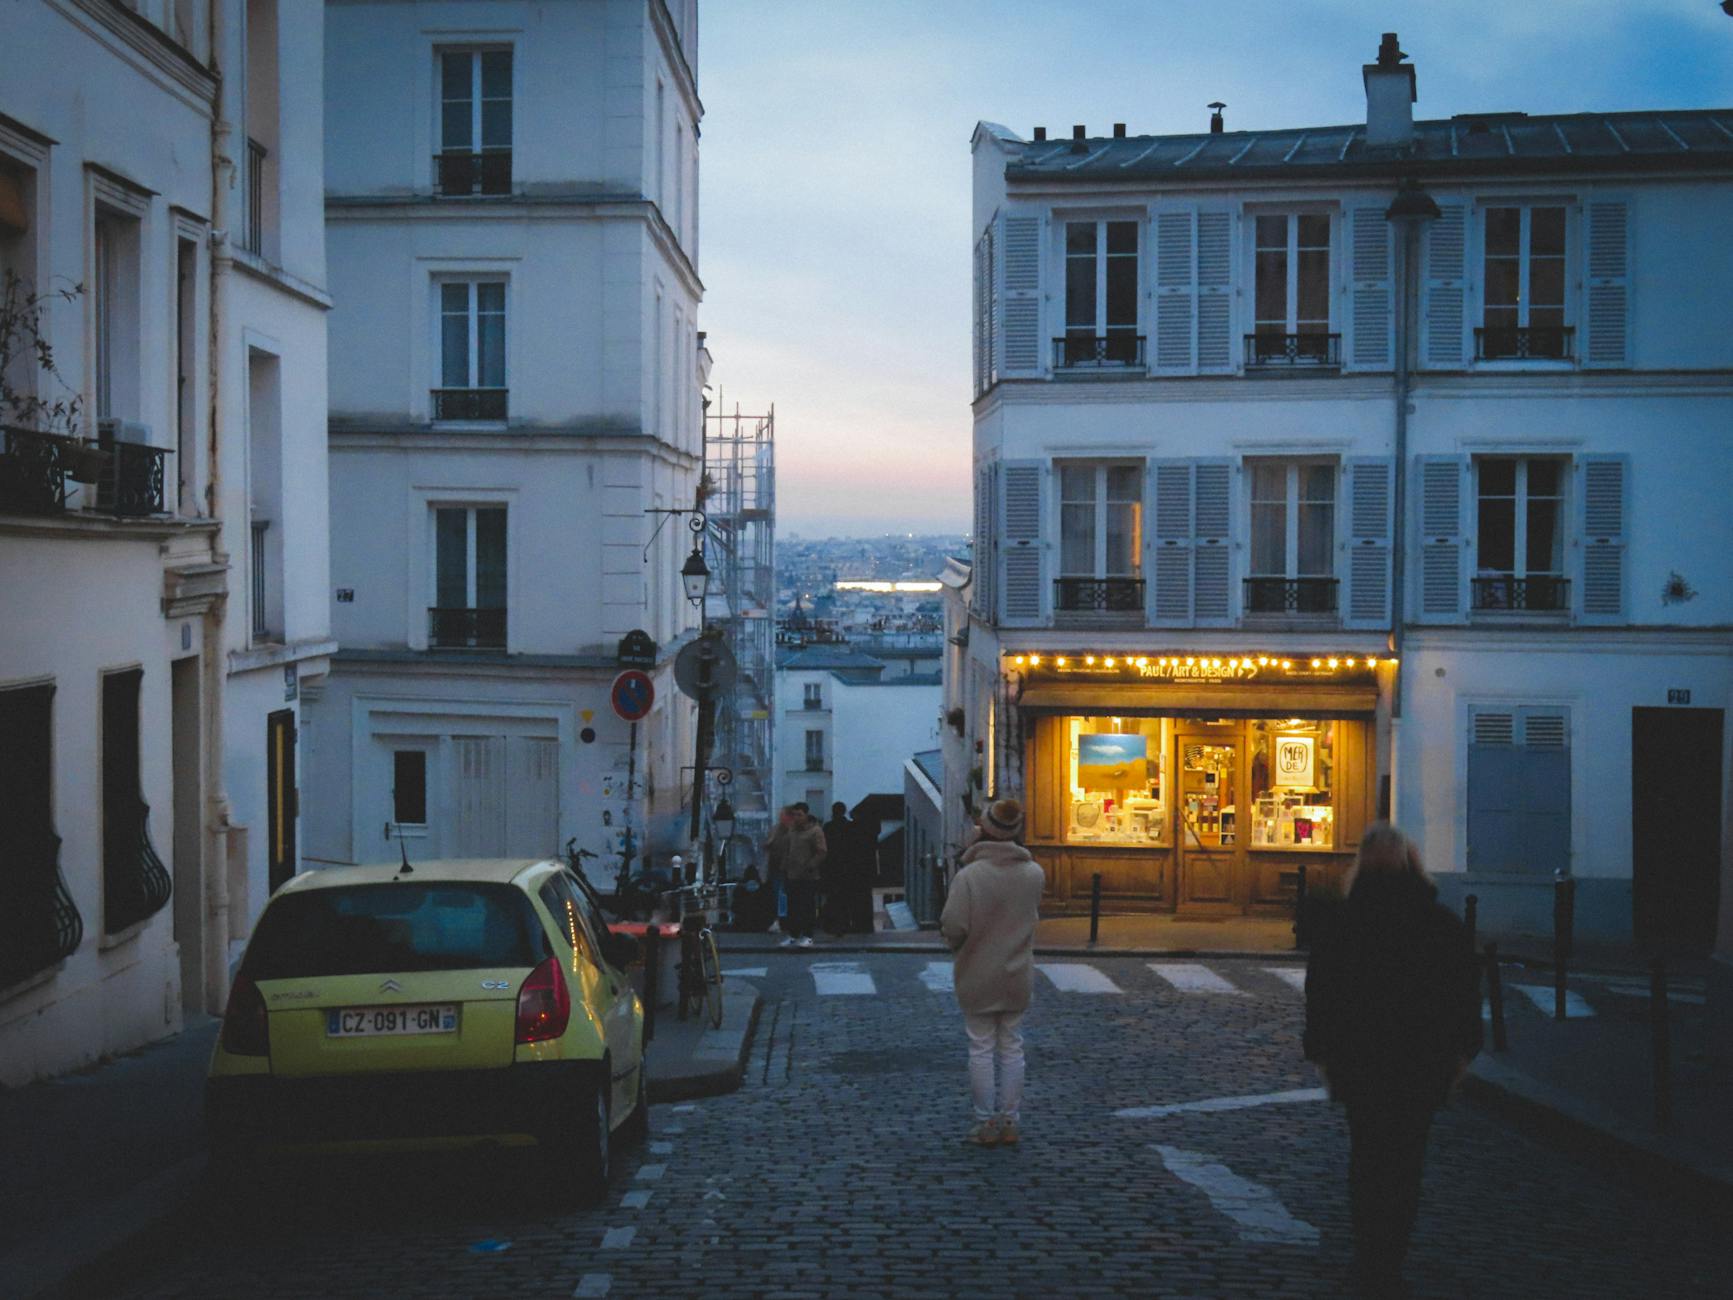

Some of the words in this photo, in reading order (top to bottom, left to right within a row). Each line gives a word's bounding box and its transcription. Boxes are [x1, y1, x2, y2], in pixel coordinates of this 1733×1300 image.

[1140, 665, 1165, 677] PAUL
[1172, 665, 1190, 677] ART
[1191, 666, 1199, 677] &
[1200, 665, 1235, 677] DESIGN
[1283, 746, 1304, 762] MER
[480, 979, 510, 991] C2
[342, 1008, 440, 1033] CZ-091-GN
